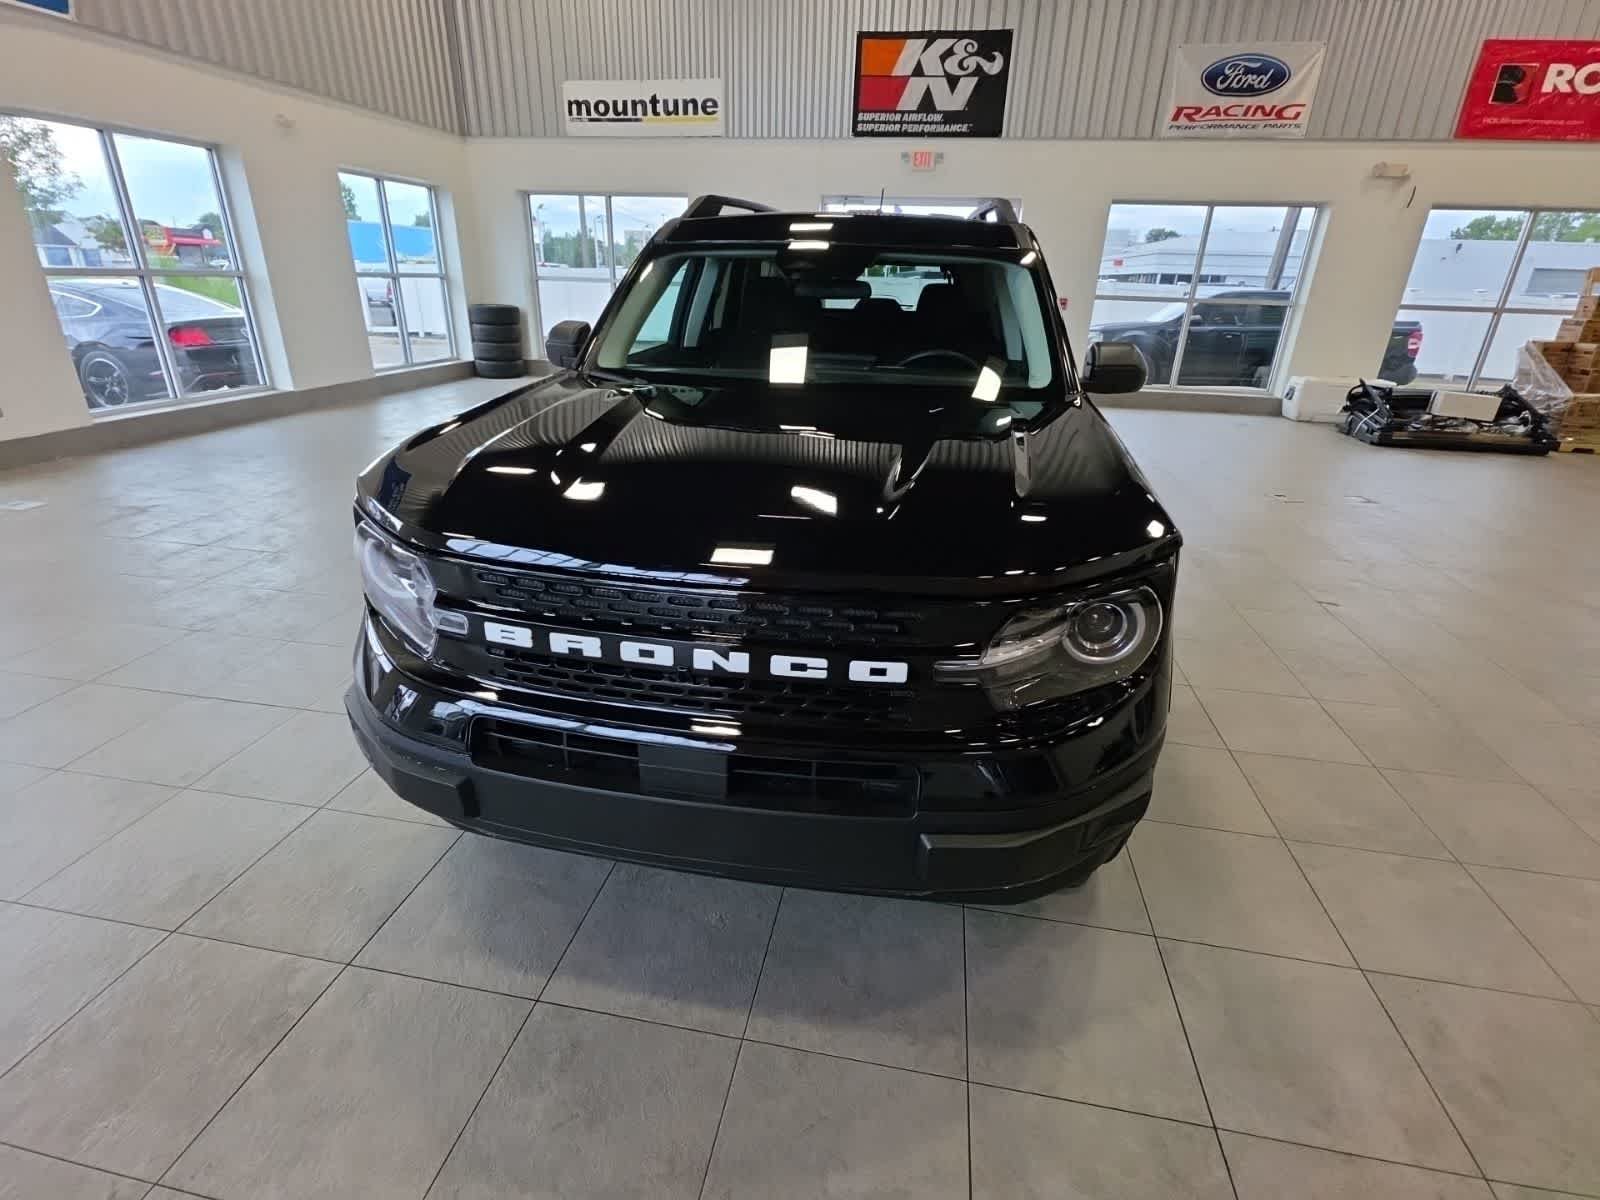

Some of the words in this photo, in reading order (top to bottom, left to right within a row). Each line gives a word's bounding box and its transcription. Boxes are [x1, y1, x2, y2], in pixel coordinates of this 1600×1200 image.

[1217, 61, 1274, 89] Ford
[567, 93, 719, 117] mountune
[1171, 103, 1307, 123] RACING
[857, 112, 902, 122] SUPERIOR
[856, 123, 901, 132] SUPERIOR
[1168, 122, 1257, 131] PERFORMANCE
[914, 151, 932, 168] EXIT
[484, 621, 909, 684] BRONCO
